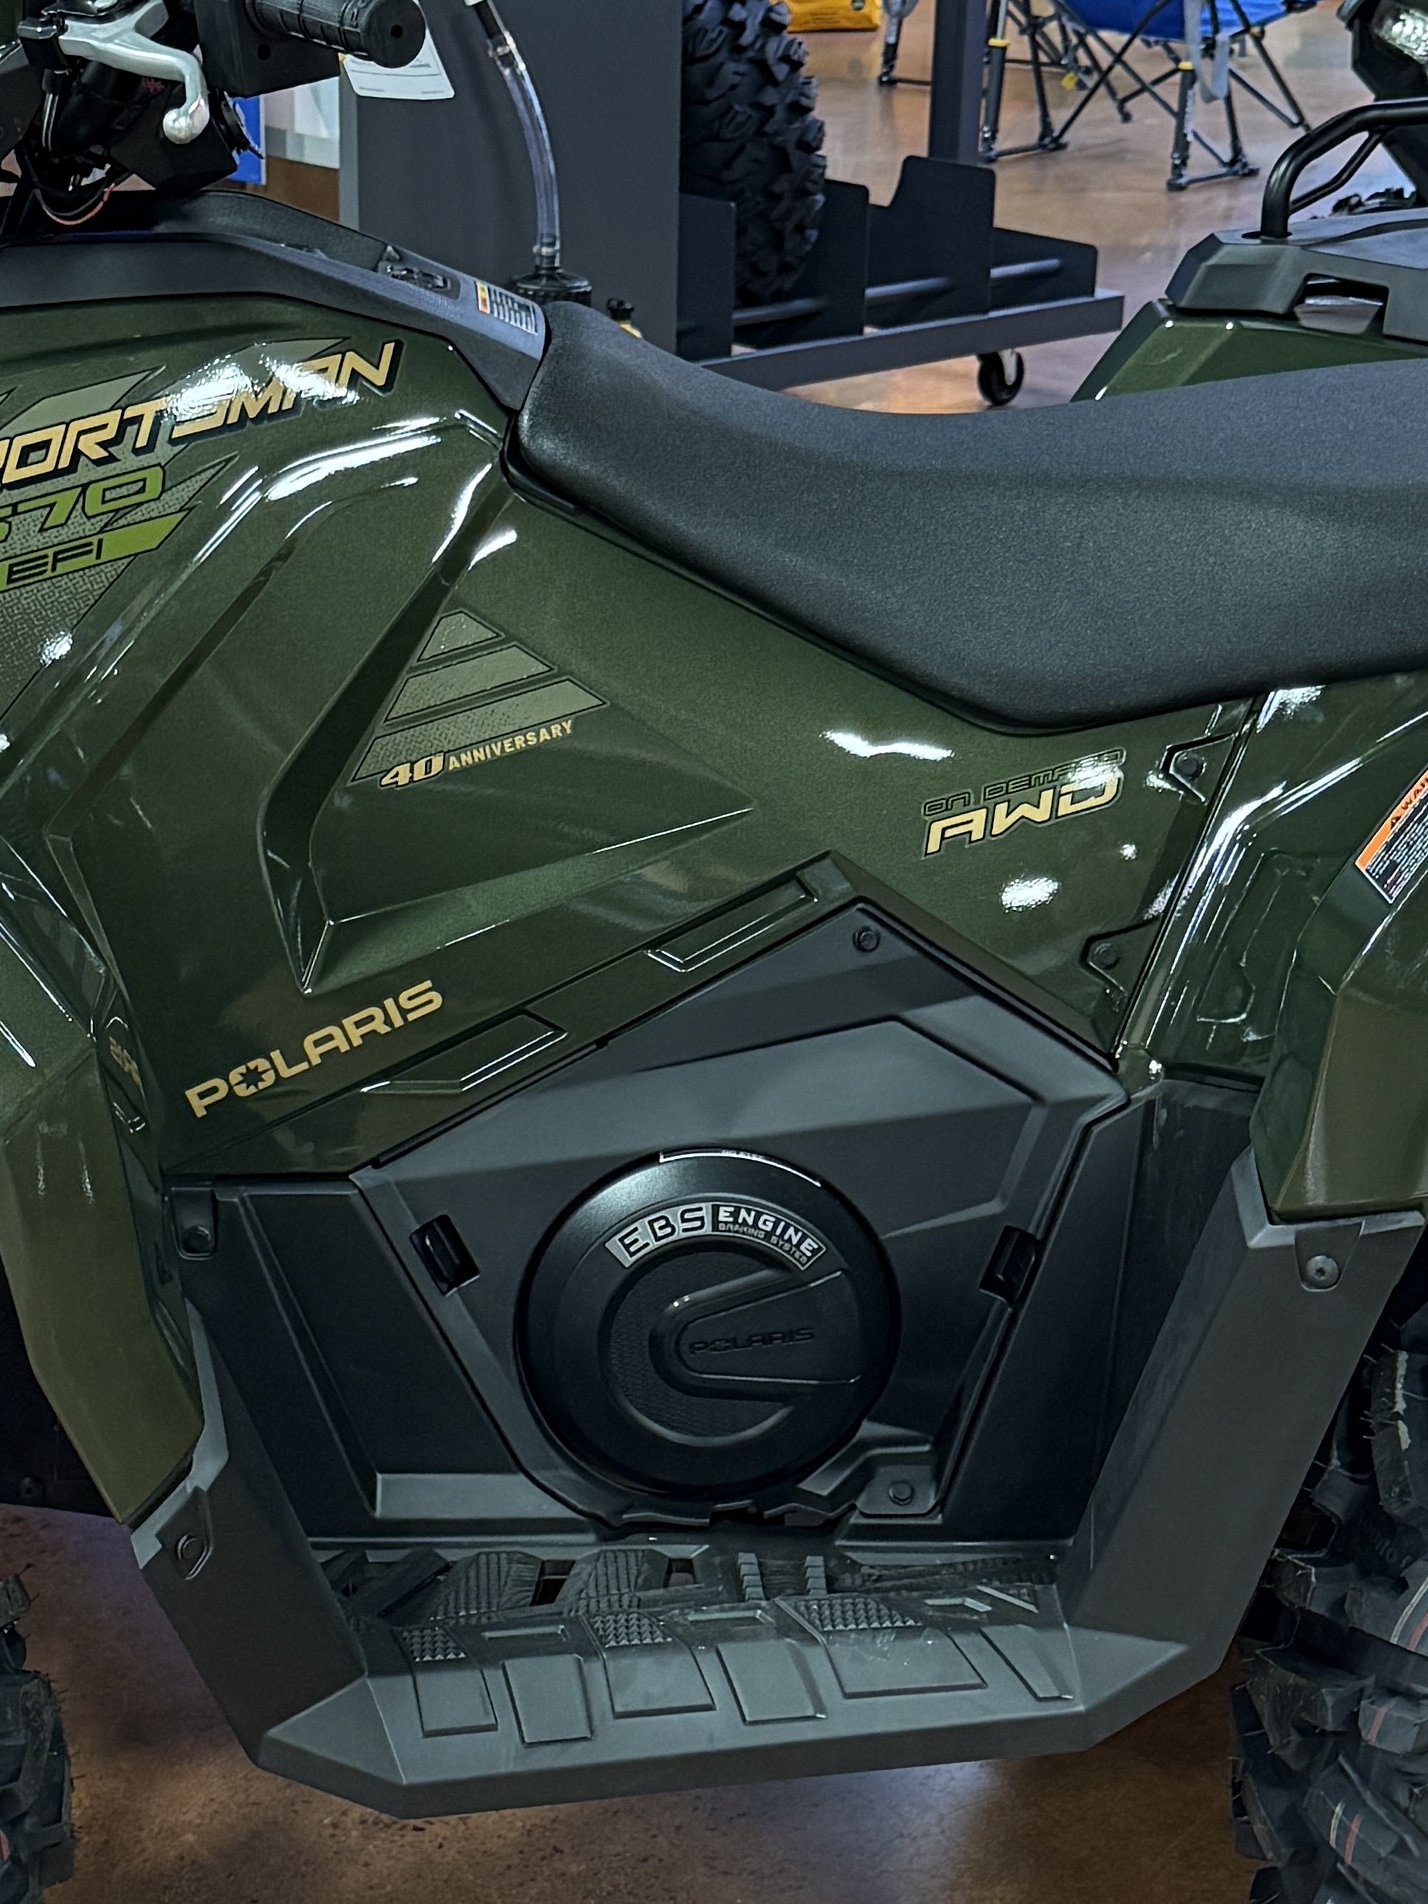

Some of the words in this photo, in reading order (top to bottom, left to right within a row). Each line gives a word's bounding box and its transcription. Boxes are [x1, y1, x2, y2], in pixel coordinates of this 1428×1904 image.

[6, 538, 105, 586] EFI
[379, 751, 446, 791] 40
[446, 718, 574, 772] ANNIVERSARY
[983, 748, 1122, 802] DEMAD
[924, 766, 1123, 855] AWD
[184, 978, 444, 1119] POLARIS
[619, 1204, 708, 1262] EBS
[717, 1206, 820, 1258] ENGINE
[689, 1327, 816, 1357] POLARIS
